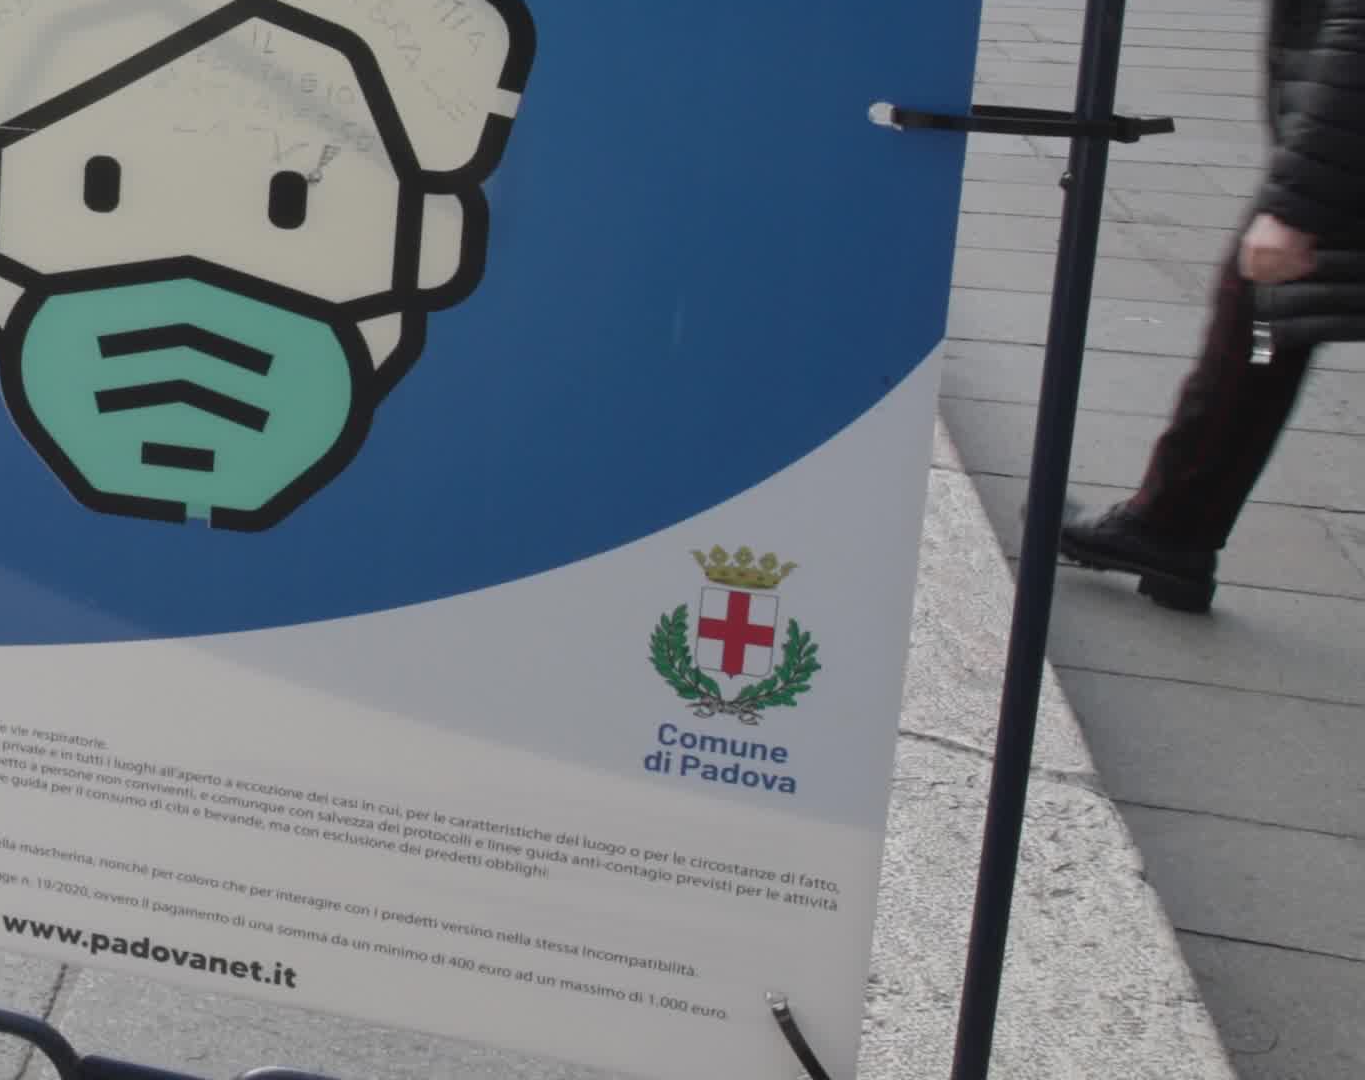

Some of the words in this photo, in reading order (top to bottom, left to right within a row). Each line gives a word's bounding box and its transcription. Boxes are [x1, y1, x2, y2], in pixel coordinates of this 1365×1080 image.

[656, 721, 789, 765] Comune
[644, 751, 672, 777] di
[680, 754, 797, 796] Padova
[1, 913, 298, 990] www.padovanet.it
